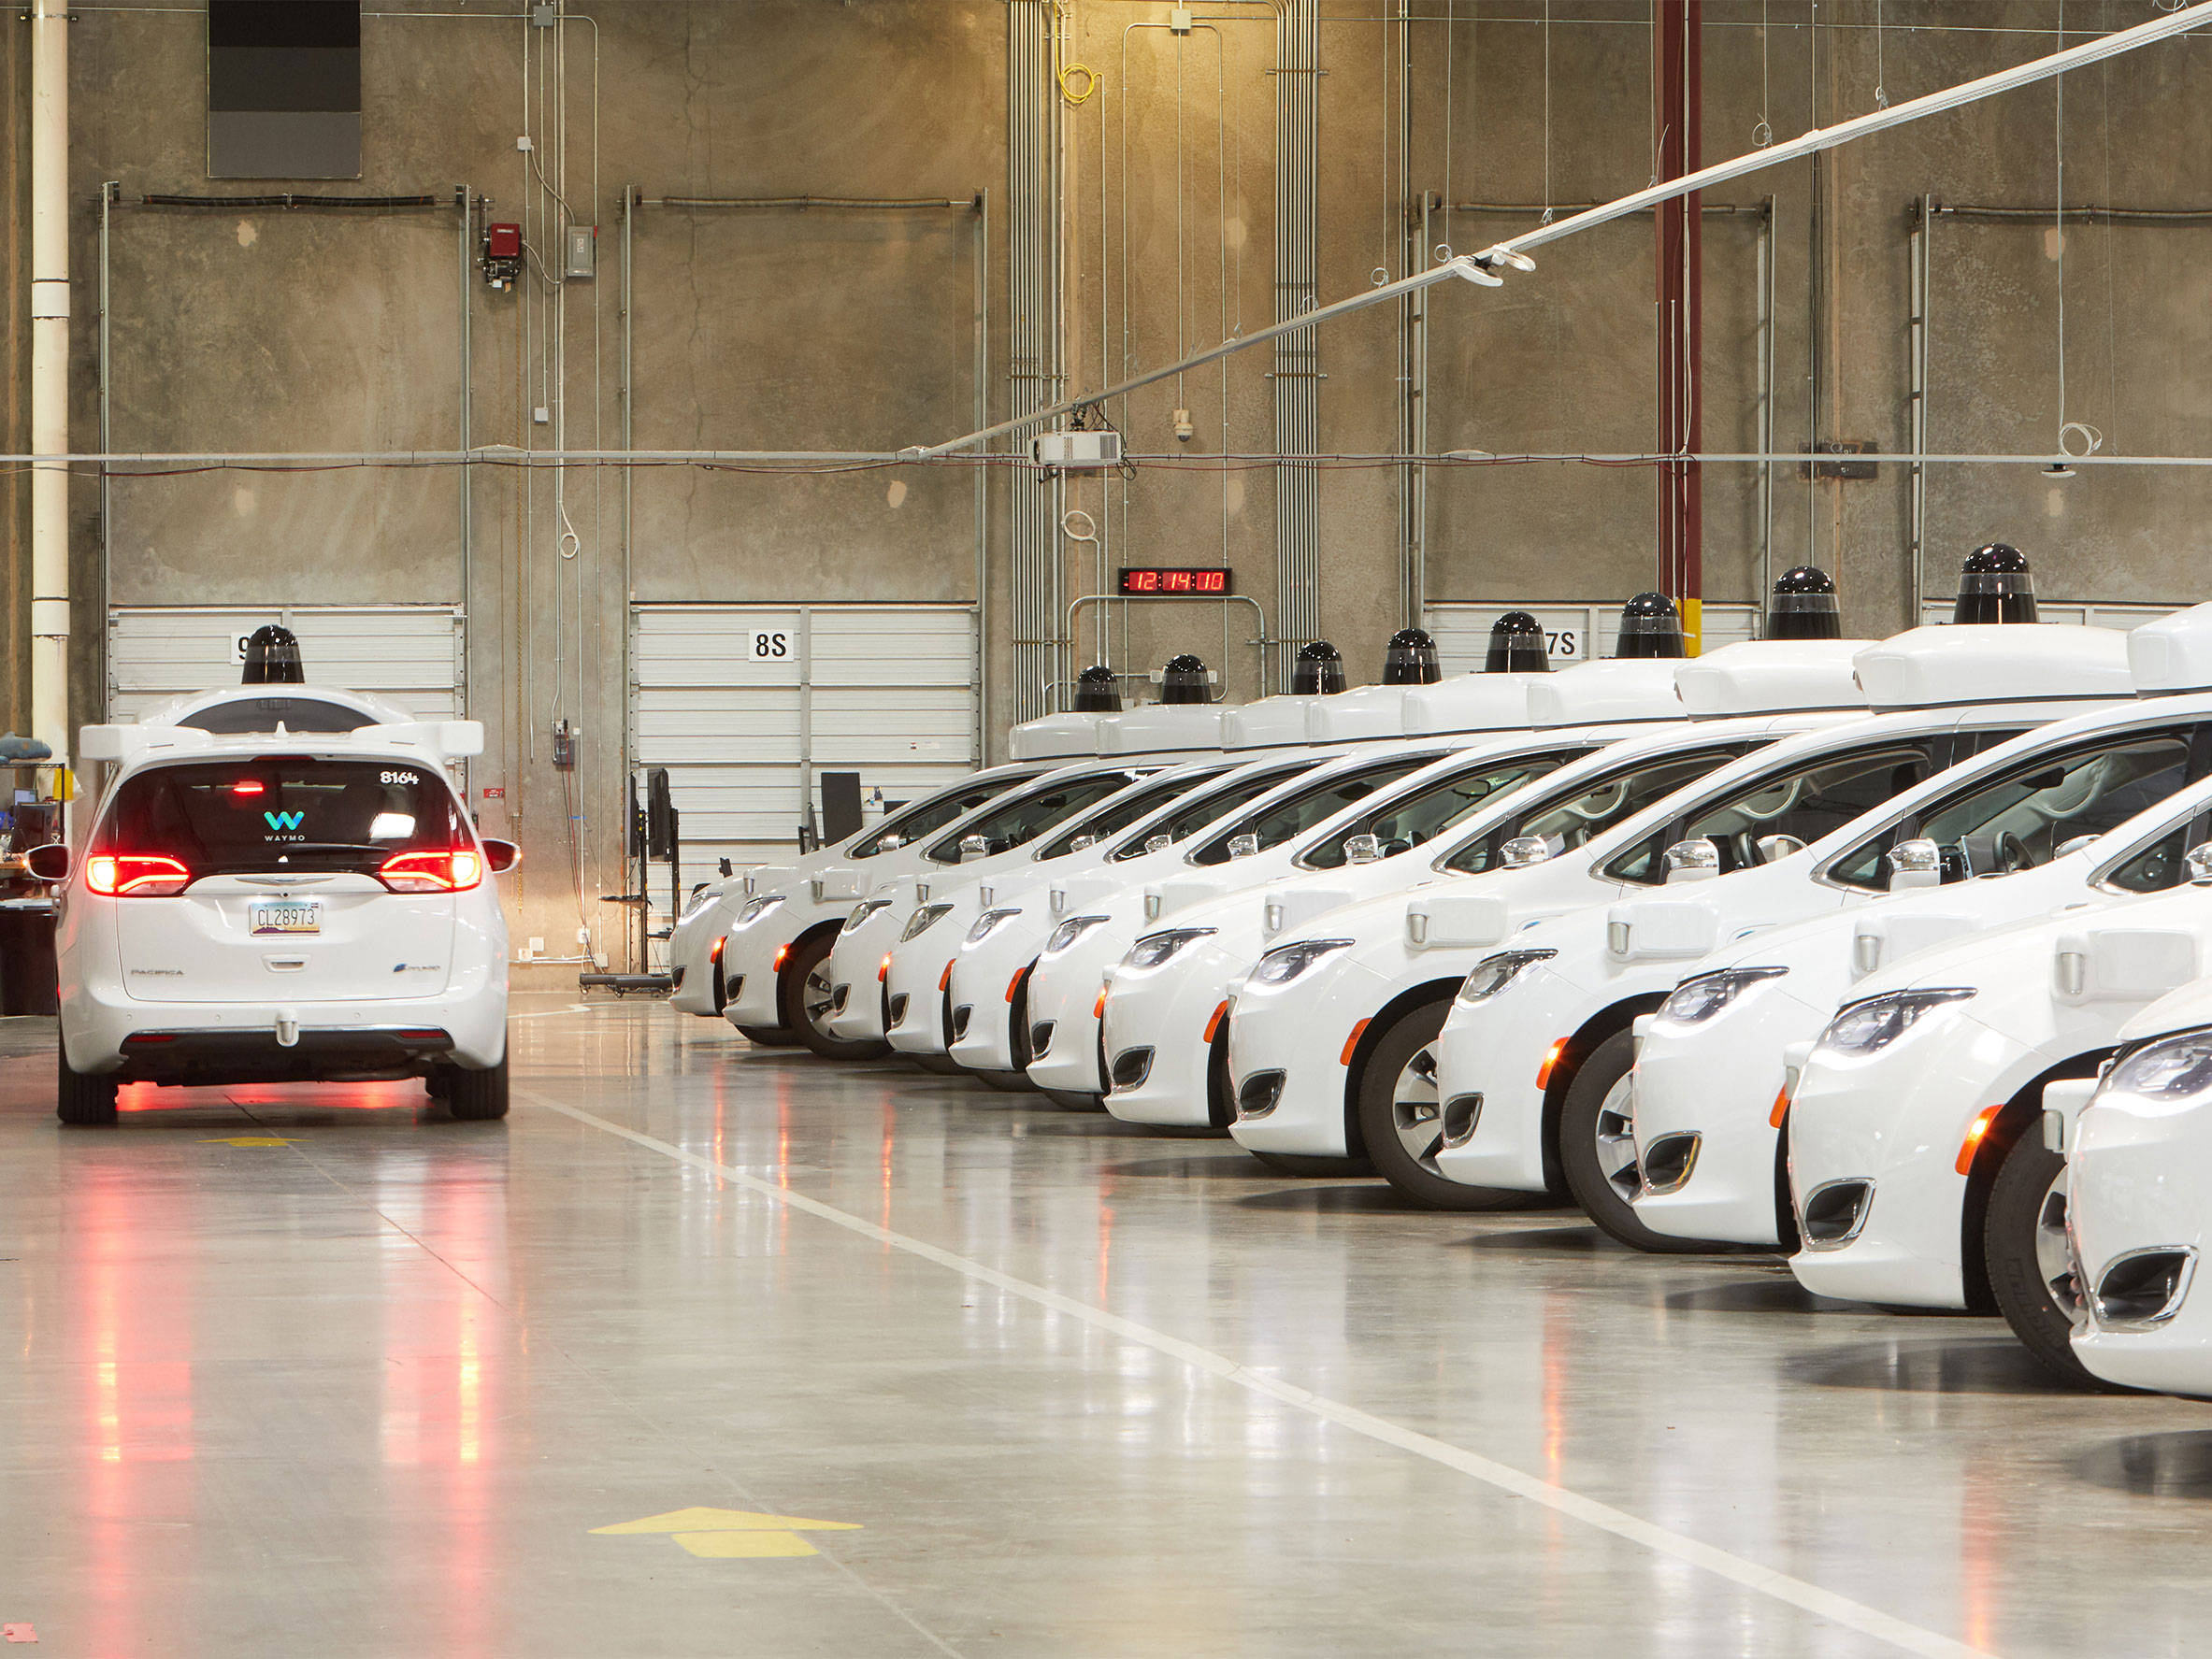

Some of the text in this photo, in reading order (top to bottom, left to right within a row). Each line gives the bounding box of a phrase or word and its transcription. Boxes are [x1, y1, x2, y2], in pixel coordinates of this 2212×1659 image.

[1138, 572, 1224, 590] 12:14:10
[238, 636, 250, 660] 9
[756, 634, 786, 657] 8S
[1545, 632, 1574, 654] 7S
[381, 771, 419, 784] 8164
[258, 908, 314, 925] CL28973
